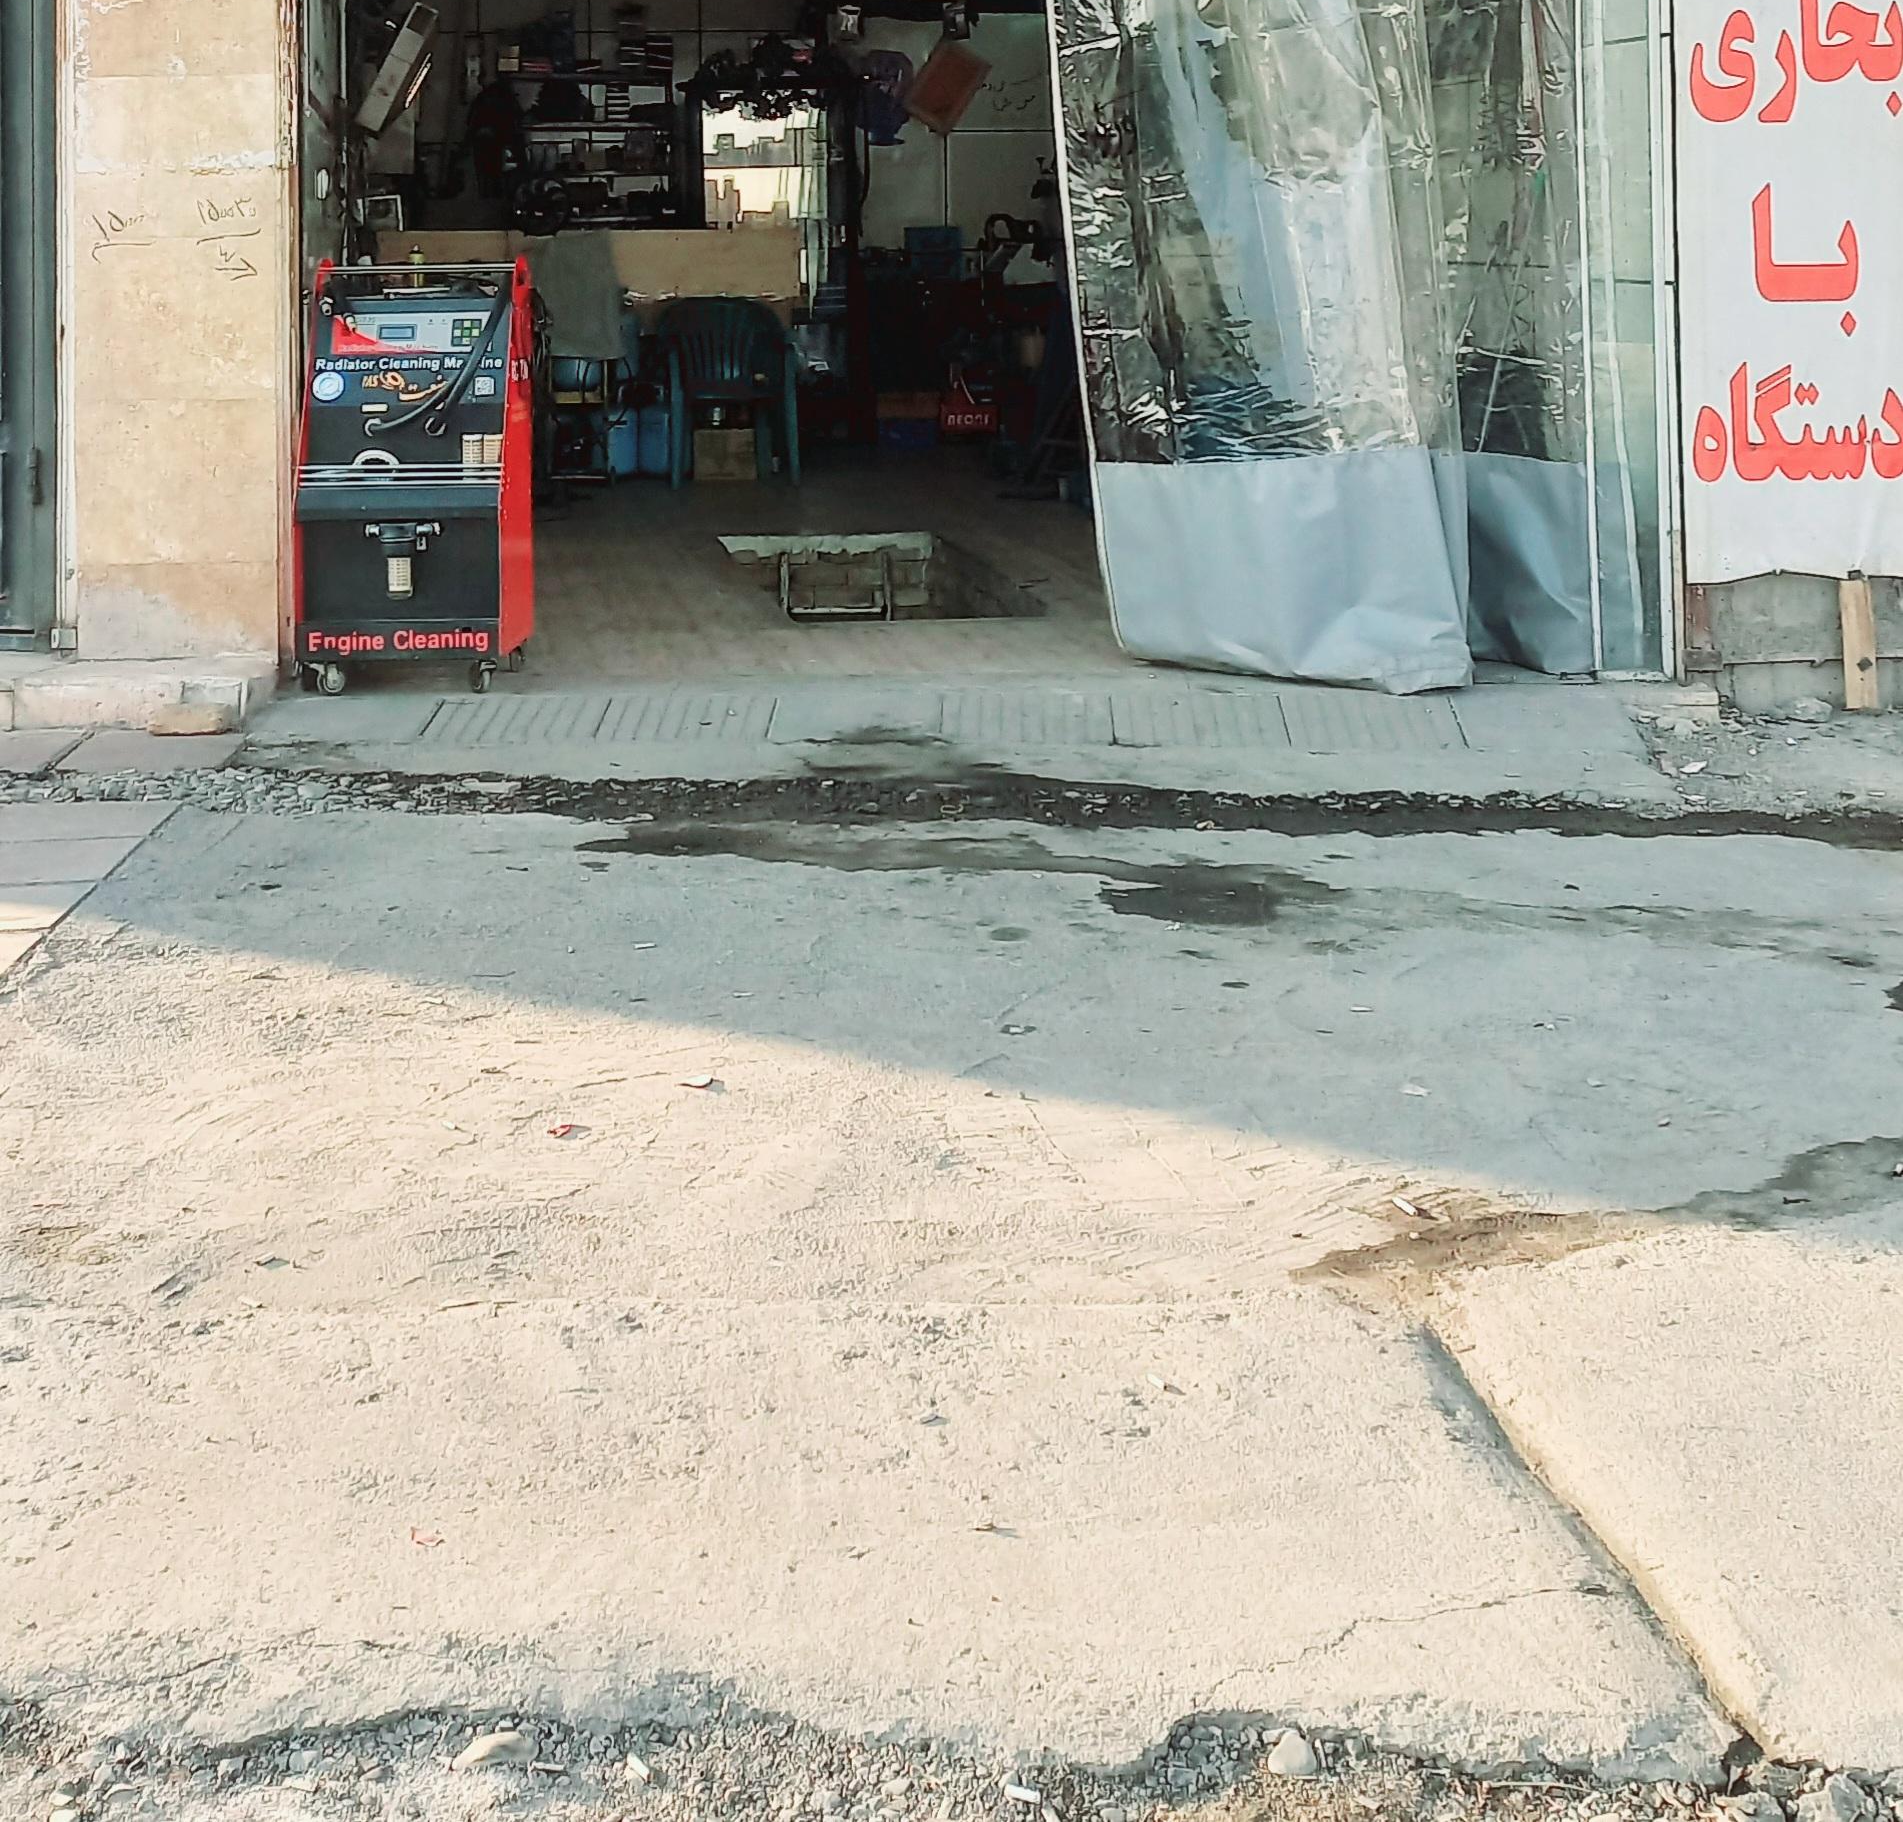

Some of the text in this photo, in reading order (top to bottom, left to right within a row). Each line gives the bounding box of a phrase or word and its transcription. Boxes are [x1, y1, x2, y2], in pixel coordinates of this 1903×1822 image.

[1752, 183, 1859, 337] با
[316, 358, 375, 371] Radiator
[379, 357, 440, 371] Cleaning
[1693, 362, 1903, 481] دستگاه
[308, 629, 489, 656] Engine Cleaning
